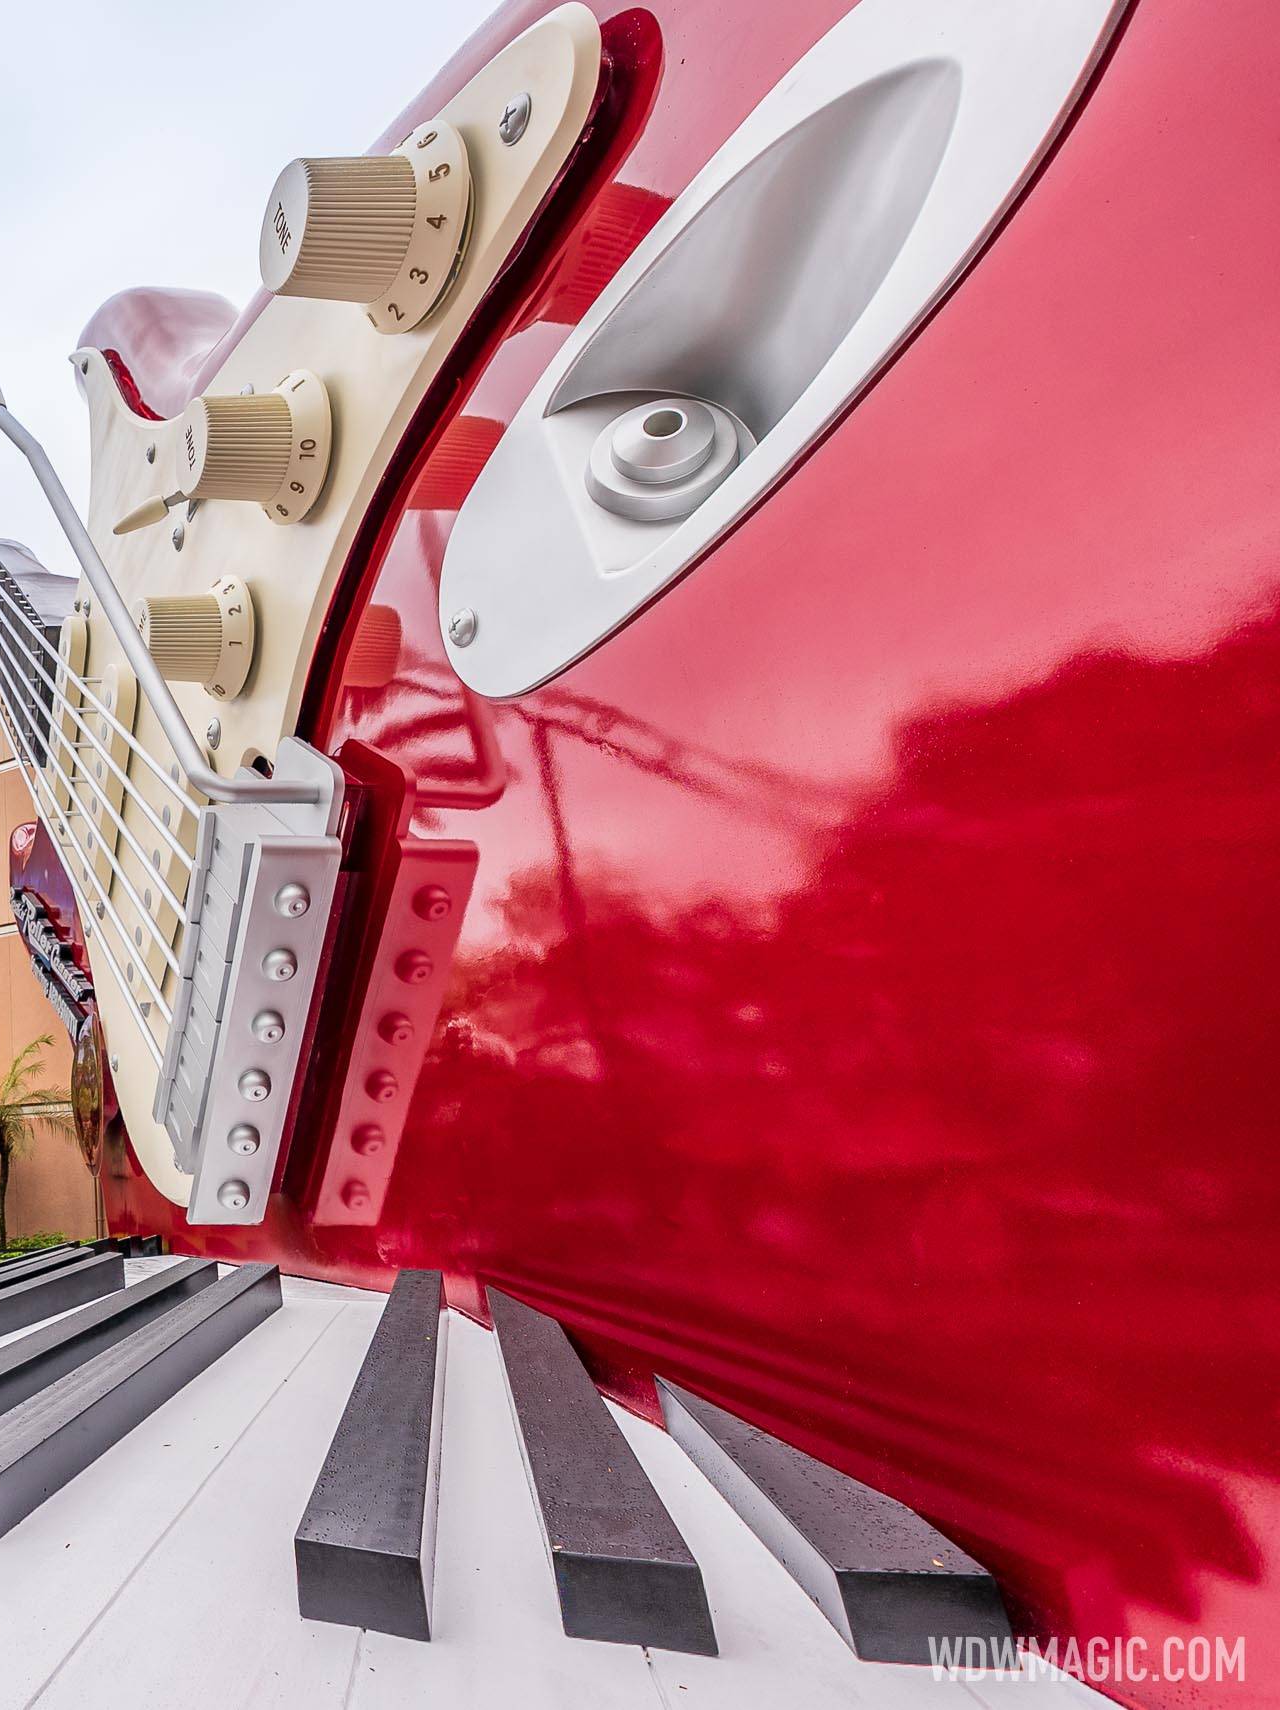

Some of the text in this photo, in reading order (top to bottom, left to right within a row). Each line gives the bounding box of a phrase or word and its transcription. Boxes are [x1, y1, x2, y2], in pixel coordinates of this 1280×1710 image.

[428, 162, 451, 183] 5
[273, 201, 291, 255] TONE
[426, 214, 447, 230] 4
[409, 267, 429, 285] 3
[387, 302, 405, 321] 2
[185, 424, 196, 471] TONE
[299, 439, 317, 460] 10
[289, 481, 305, 494] 9
[276, 504, 289, 517] 8
[228, 604, 242, 616] 2
[212, 684, 226, 697] 10
